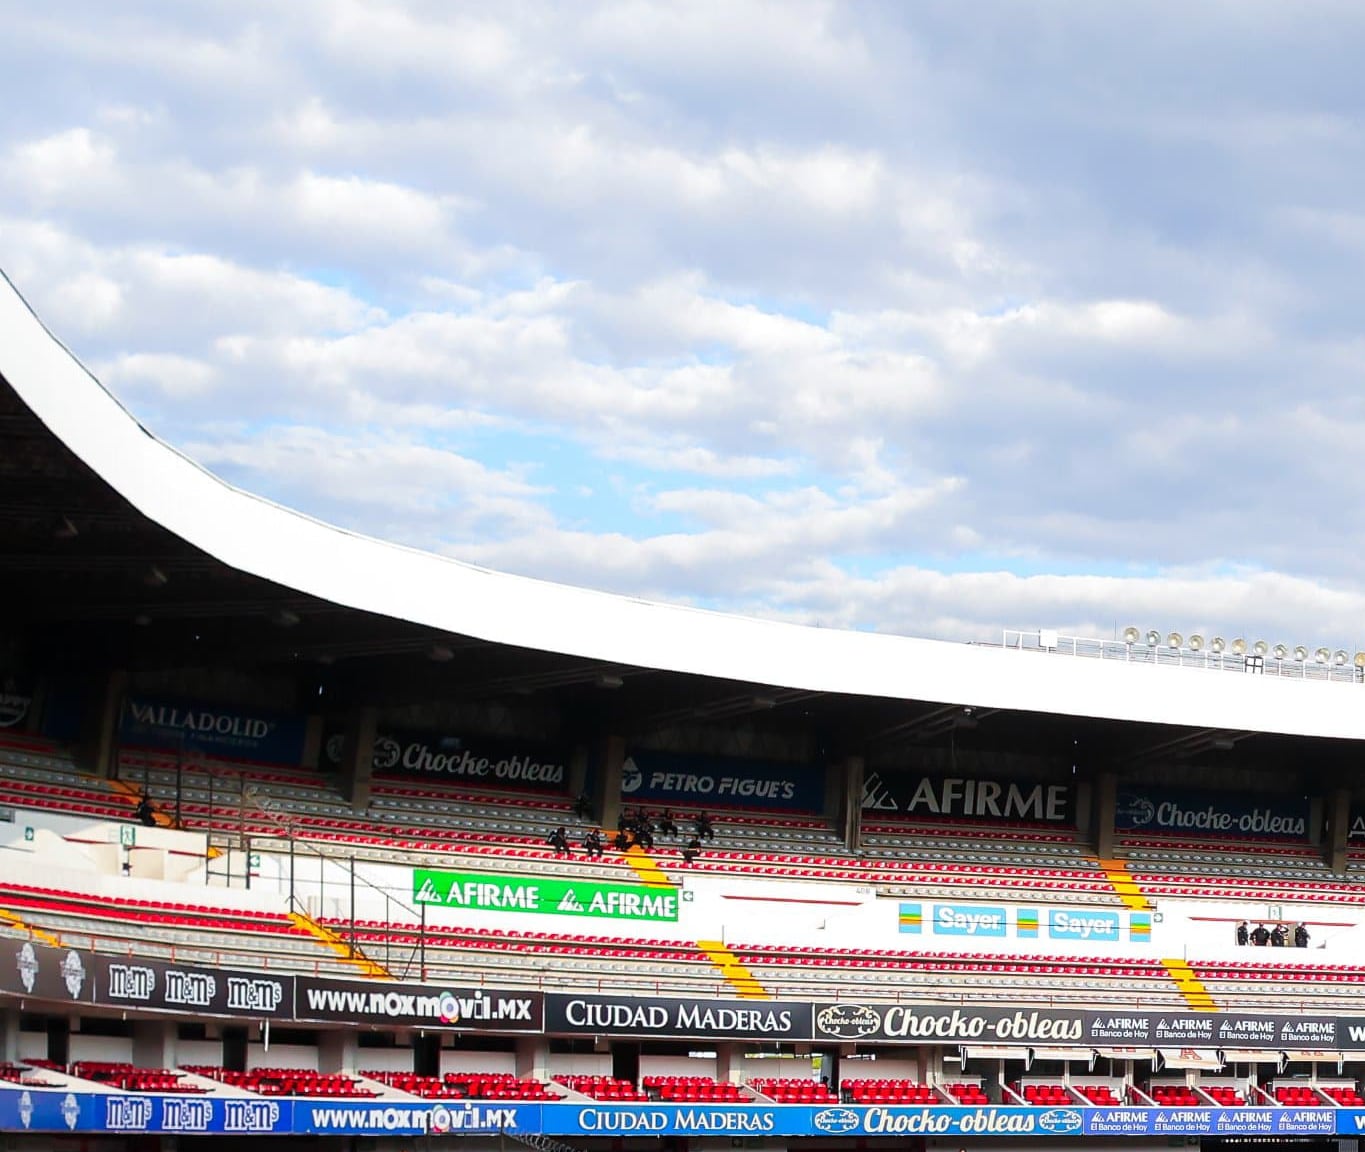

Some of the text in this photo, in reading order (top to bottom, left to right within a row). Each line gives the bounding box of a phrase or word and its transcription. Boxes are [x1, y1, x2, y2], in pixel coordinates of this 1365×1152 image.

[131, 703, 268, 738] VALLADOLID
[650, 772, 795, 799] PETRO FIGUE'S
[907, 778, 1067, 820] AFIRME
[447, 882, 539, 910] AFIRME
[587, 891, 675, 917] AFIRME
[566, 1001, 791, 1032] CIUDAD MADERAS
[884, 1007, 1082, 1039] Chocko-obleas
[1107, 1018, 1149, 1029] AFIRME
[1171, 1019, 1212, 1030] AFIRME
[1099, 1030, 1122, 1038] Banco
[1134, 1031, 1148, 1039] Hoy
[1234, 1020, 1275, 1032] AFIRME
[1296, 1022, 1335, 1033] AFIRME
[579, 1109, 773, 1131] CIUDAD MADERAS
[864, 1108, 1034, 1133] Chocko-obleas
[1106, 1112, 1148, 1123] AFIRME
[1170, 1112, 1211, 1123] AFIRME
[1232, 1112, 1273, 1123] AFIRME
[1293, 1112, 1332, 1123] AFIRME
